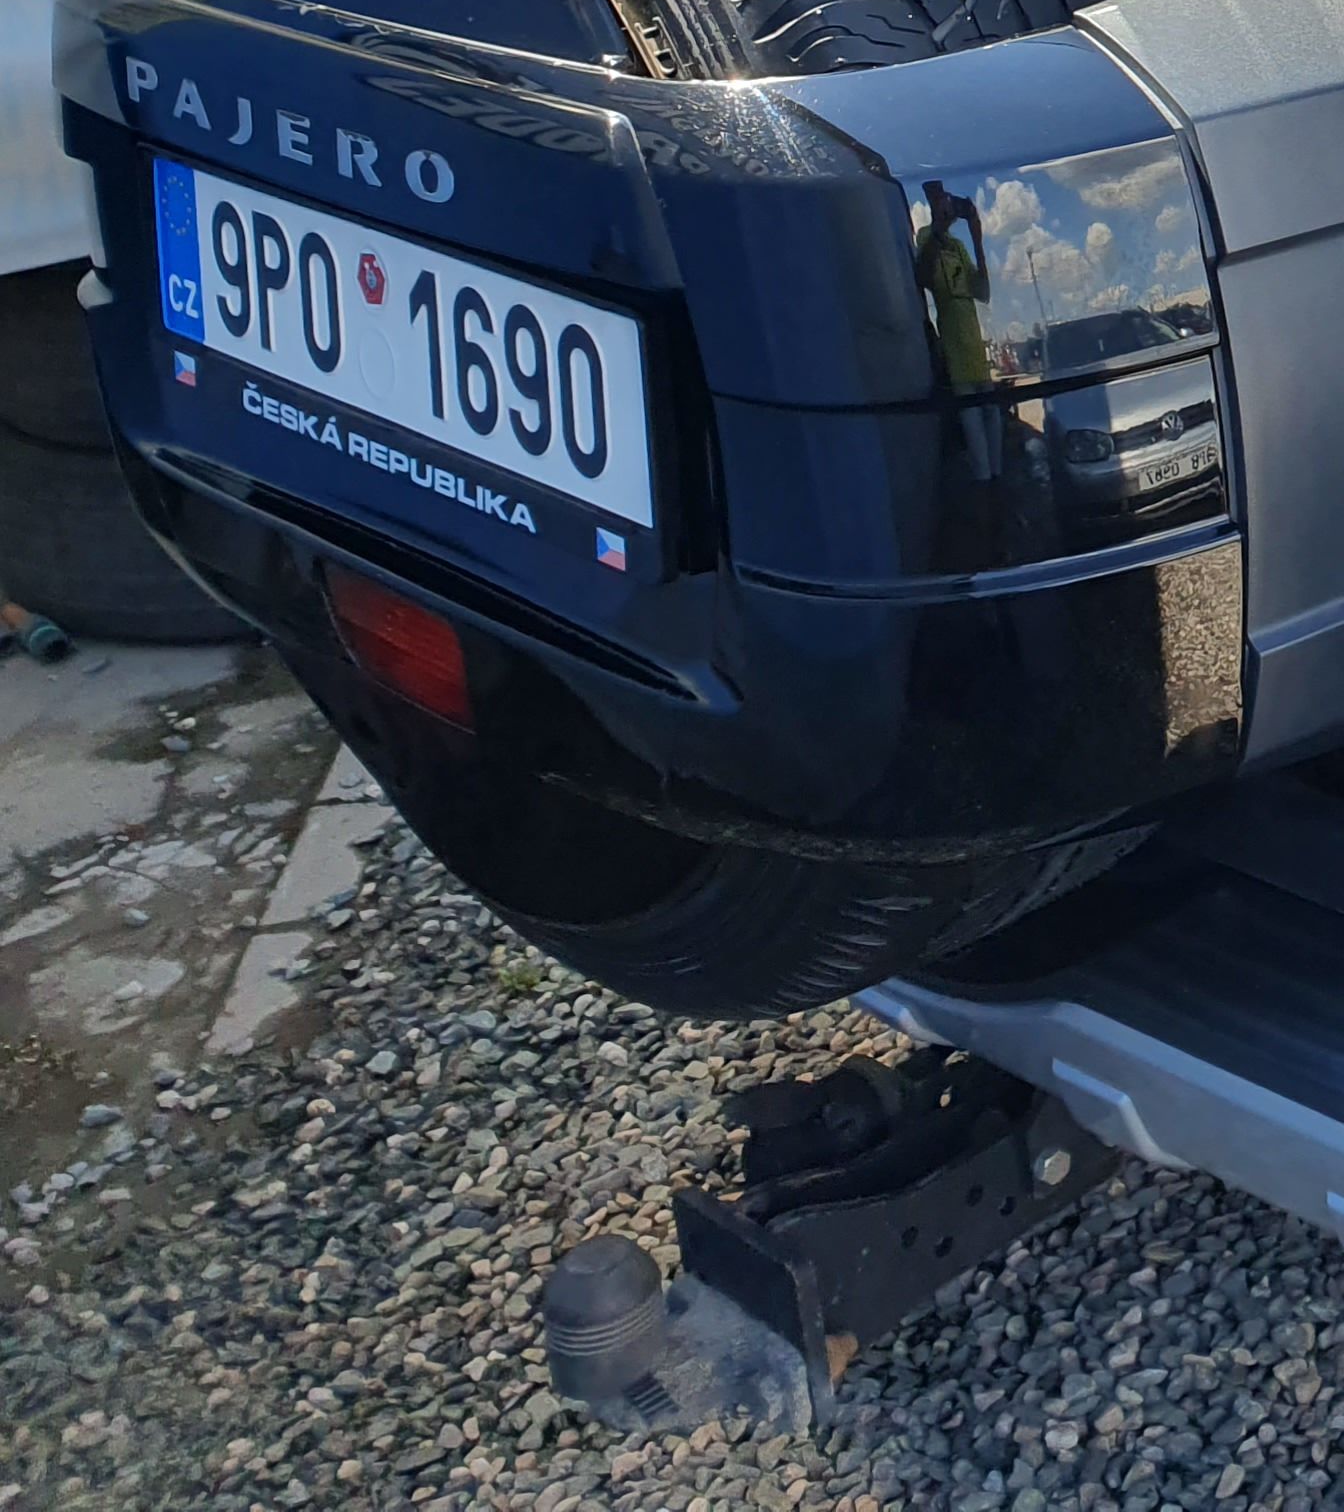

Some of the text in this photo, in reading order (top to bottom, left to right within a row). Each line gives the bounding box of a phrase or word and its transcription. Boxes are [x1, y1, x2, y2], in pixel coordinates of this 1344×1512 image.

[126, 55, 455, 205] PAJERO
[167, 273, 199, 320] CZ
[211, 199, 609, 479] 9P0 1690
[241, 381, 537, 534] ČESKÁ REPUBLIKA
